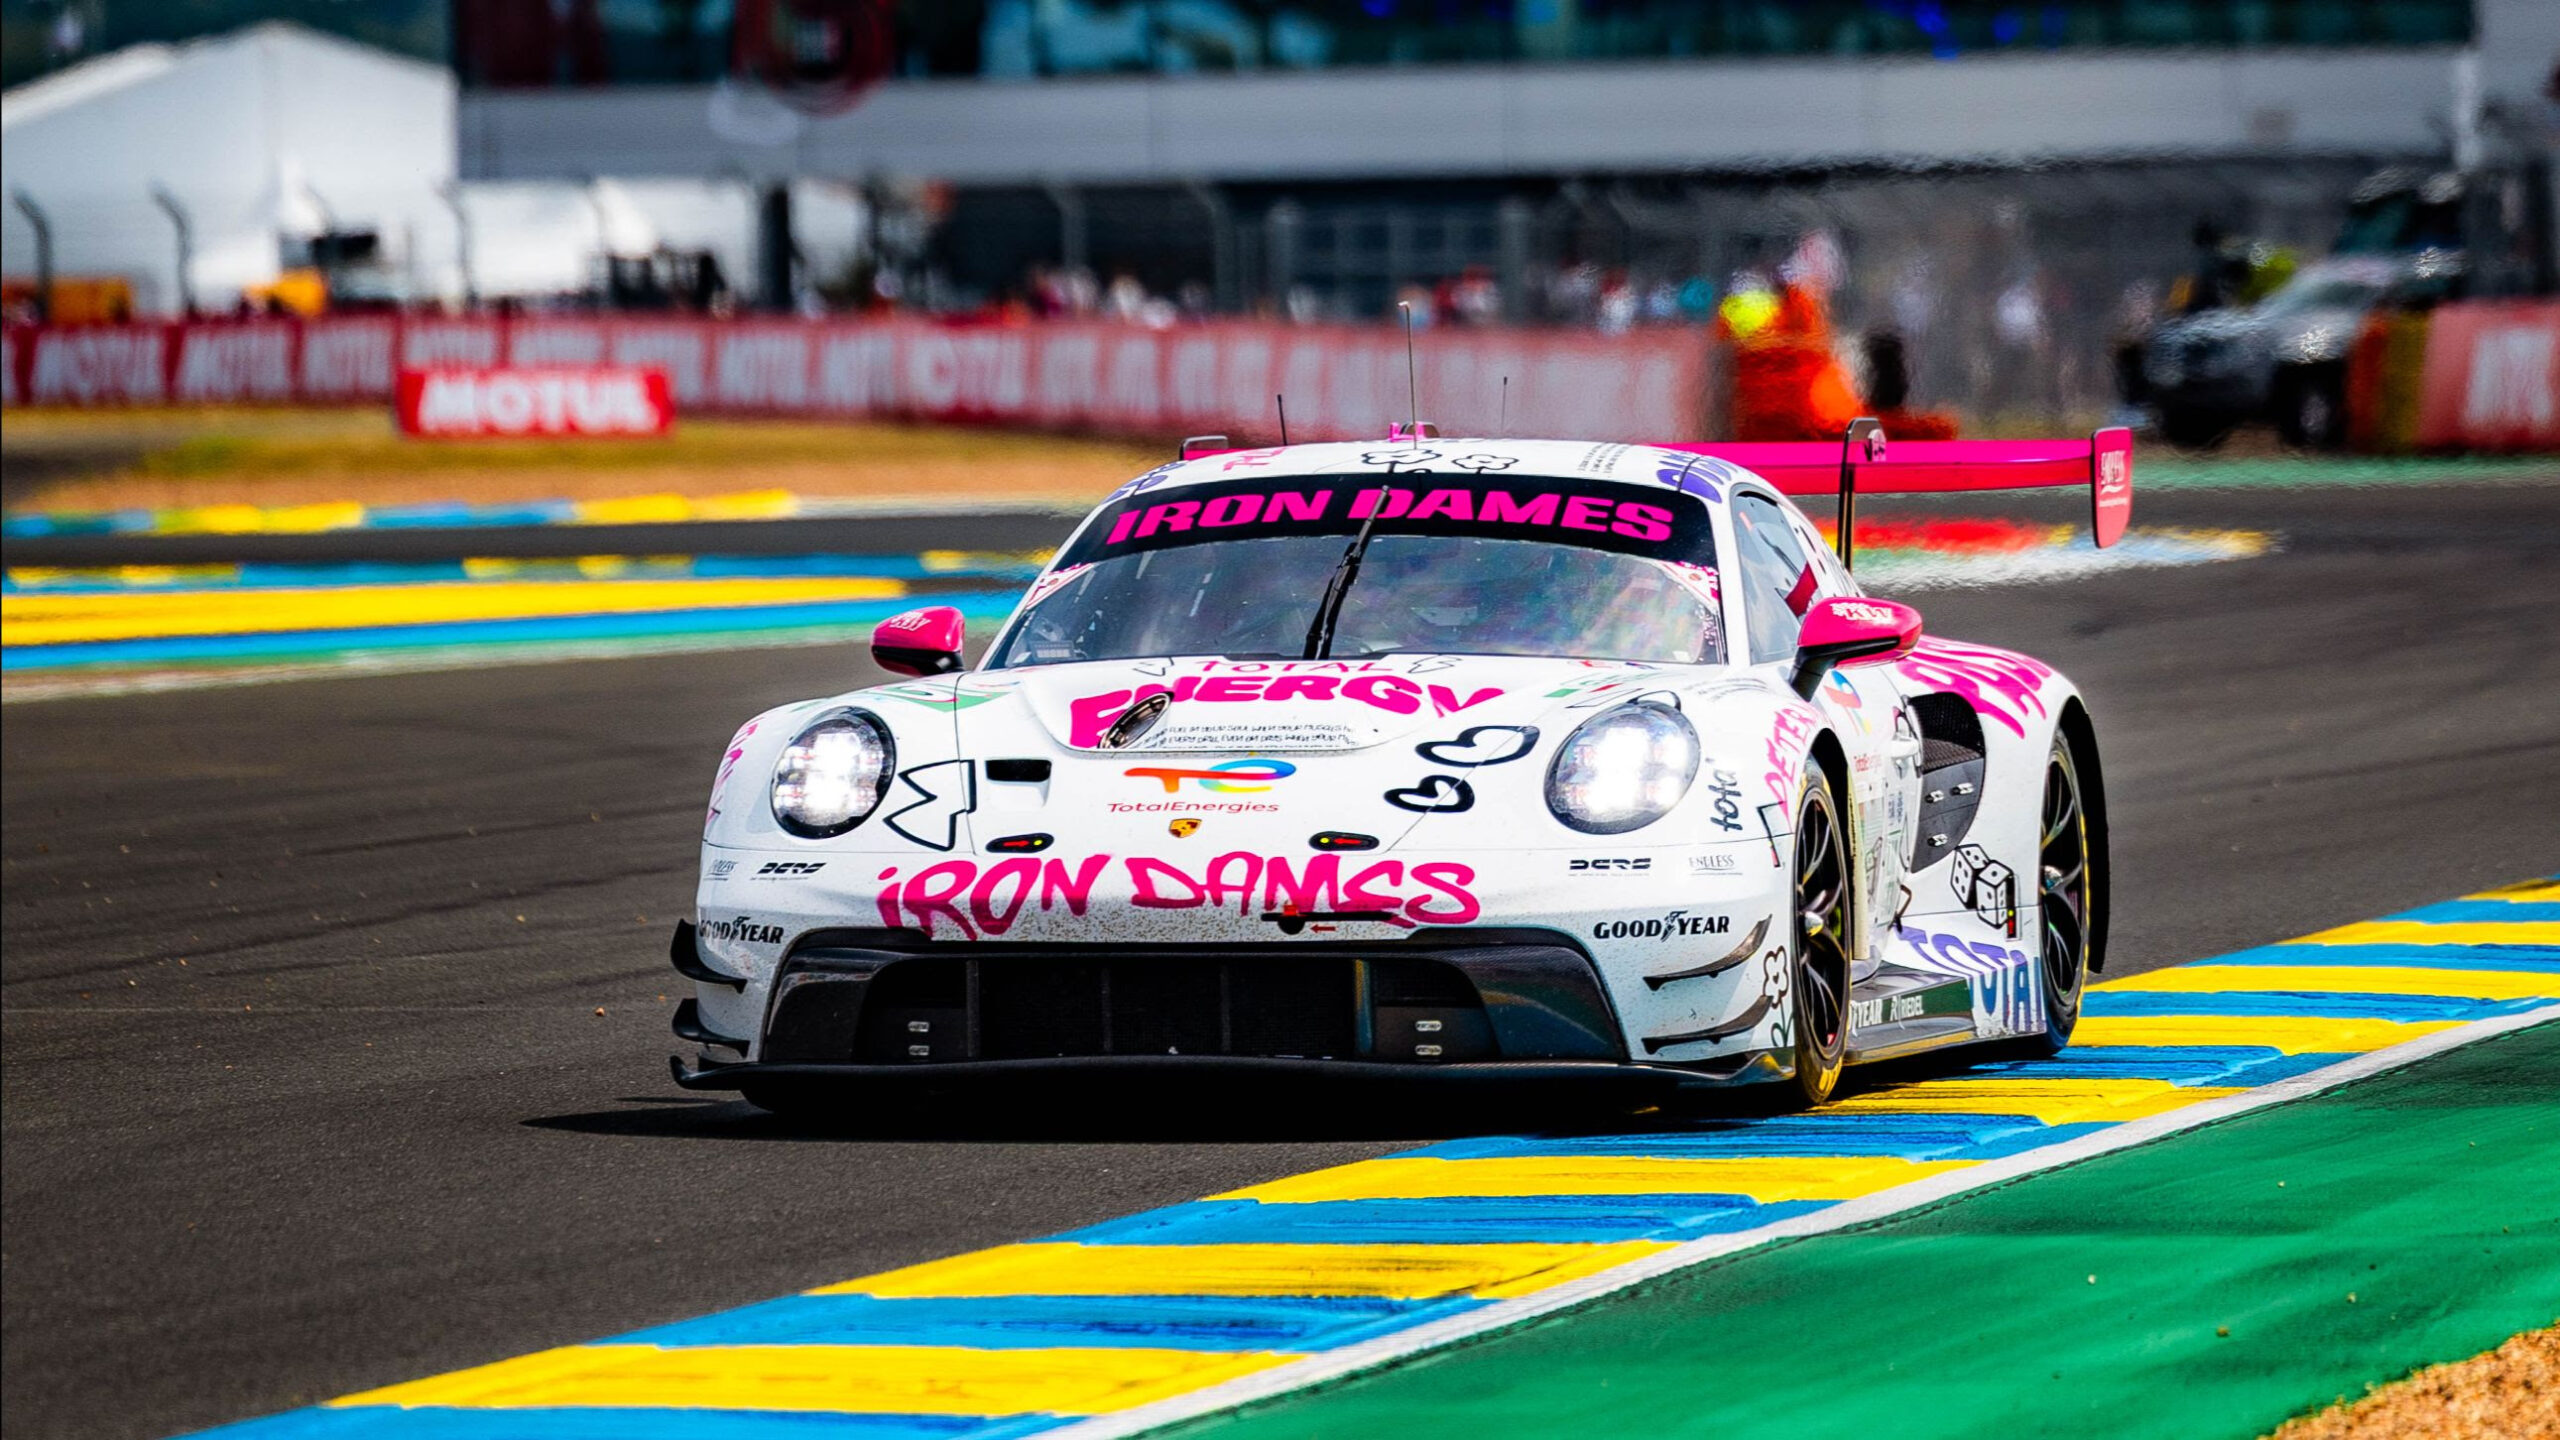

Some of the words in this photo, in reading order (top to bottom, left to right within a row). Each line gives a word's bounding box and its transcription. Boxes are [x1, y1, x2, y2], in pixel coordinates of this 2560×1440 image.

[419, 371, 661, 434] MOTUL
[1106, 490, 1333, 546] IRON
[1347, 488, 1674, 542] DAMES
[1197, 660, 1395, 673] TOTAL
[1107, 801, 1280, 815] TotalEnergies
[1706, 757, 1744, 832] tota
[1593, 914, 1731, 940] GOODYEAR
